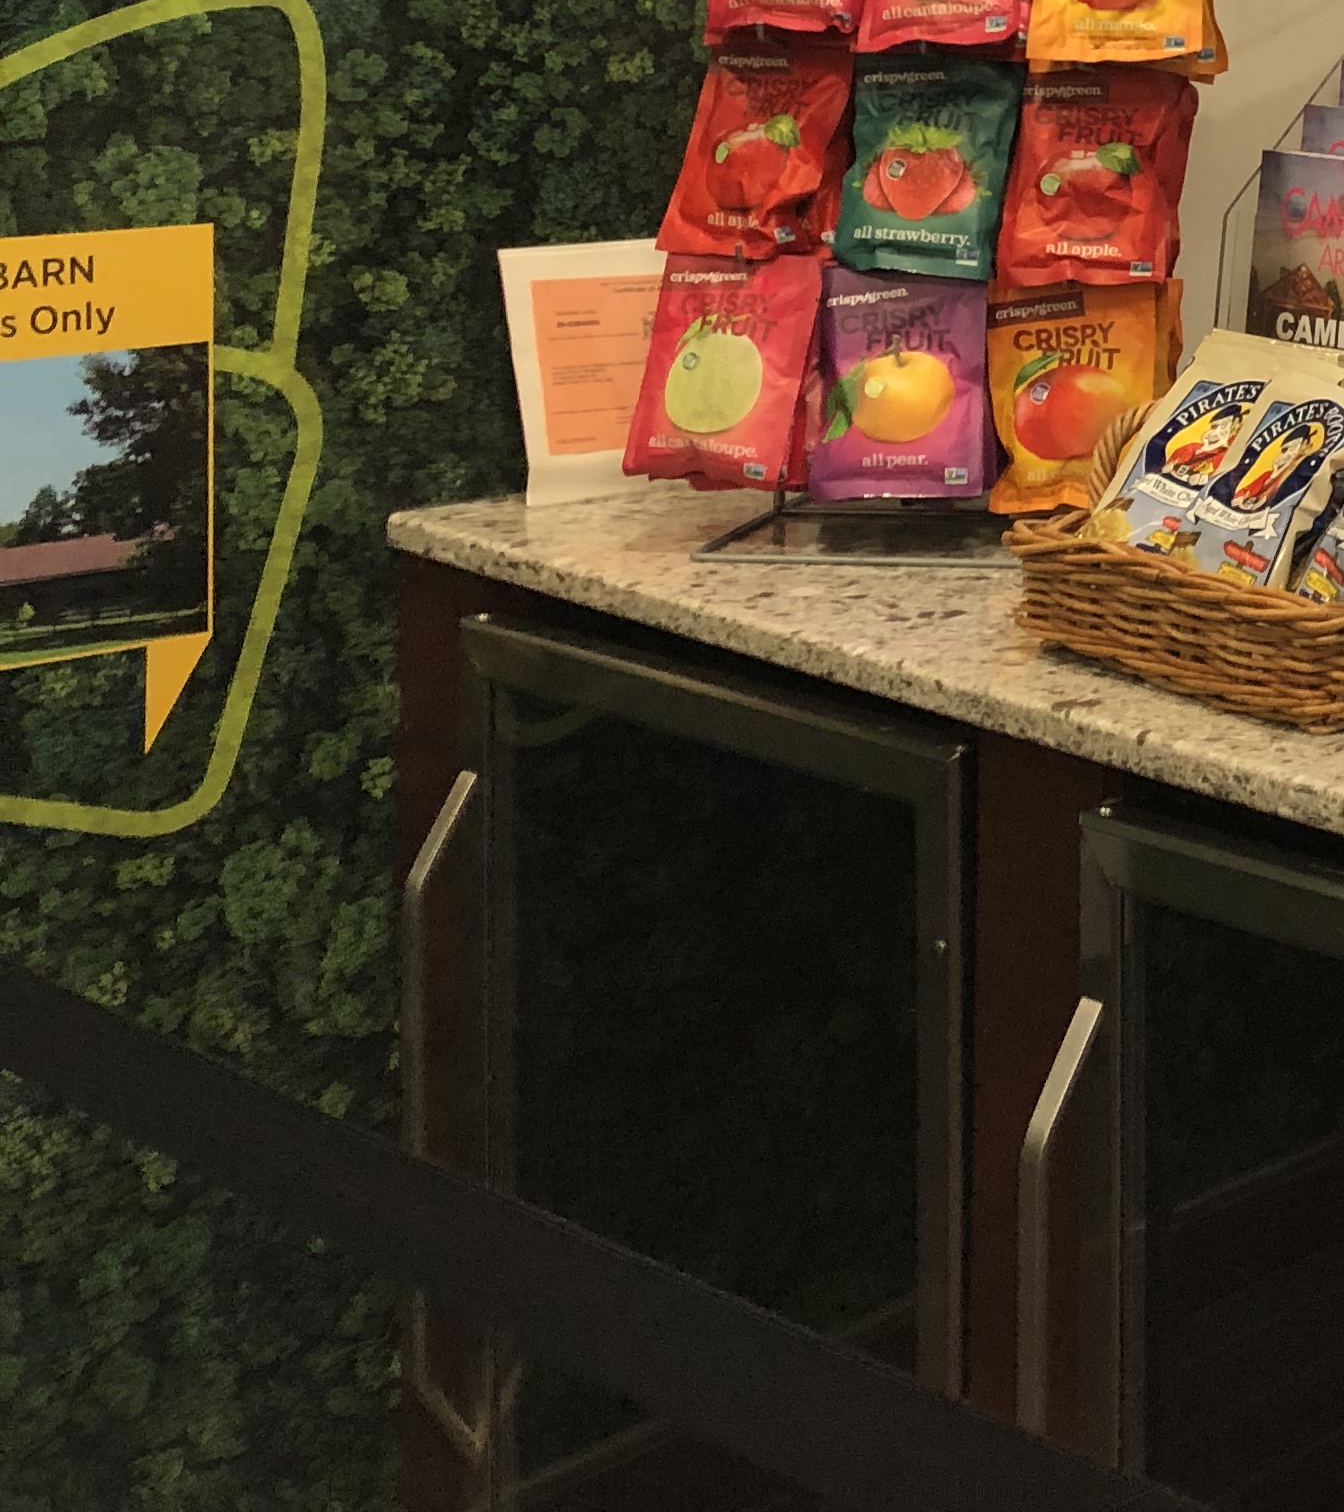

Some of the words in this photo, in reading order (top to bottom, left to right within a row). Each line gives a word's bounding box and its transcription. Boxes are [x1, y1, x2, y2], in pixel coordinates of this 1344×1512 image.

[882, 6, 904, 21] all
[707, 212, 725, 226] all
[853, 226, 872, 240] all
[874, 228, 971, 247] strawberry.
[1046, 242, 1070, 256] all
[1071, 244, 1122, 259] apple.
[30, 301, 116, 335] Only
[1012, 322, 1115, 352] CRISPY
[1176, 383, 1261, 426] PIRATE'S
[1251, 400, 1329, 452] PIRATE'S
[861, 453, 884, 467] all
[887, 454, 929, 469] pear.
